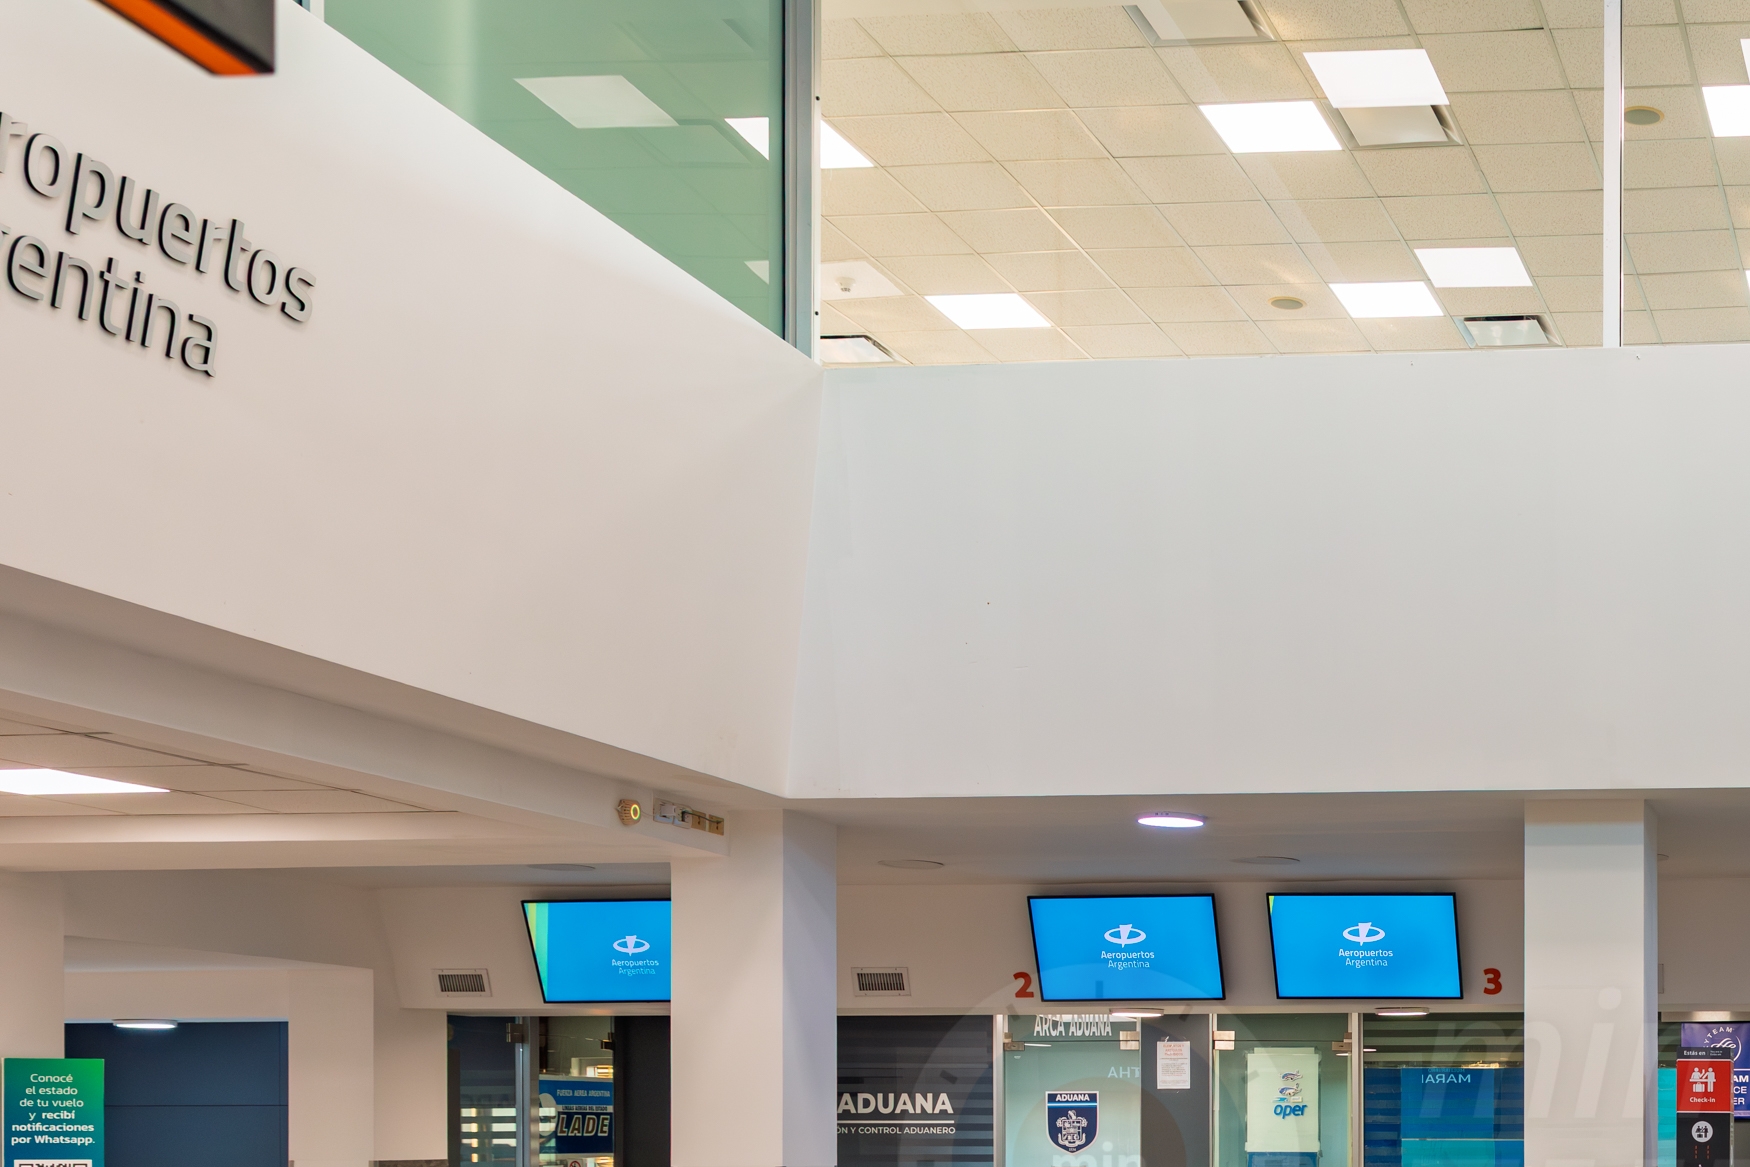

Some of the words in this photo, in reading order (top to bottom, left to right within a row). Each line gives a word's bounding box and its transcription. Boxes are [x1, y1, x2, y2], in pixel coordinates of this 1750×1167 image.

[0, 224, 218, 377] entina
[1101, 950, 1155, 961] Aeropuertos
[1339, 949, 1393, 959] Aeropuertos
[611, 959, 660, 968] Aeropuertos
[1108, 960, 1150, 970] Argentina
[1346, 958, 1388, 968] Argentina
[1013, 971, 1034, 998] 2
[1483, 968, 1503, 995] 3
[1034, 1014, 1065, 1036] ARCA
[1069, 1014, 1112, 1036] ADUANA
[30, 1073, 73, 1083] Conocé
[25, 1086, 36, 1094] el
[39, 1086, 78, 1095] estado
[19, 1098, 34, 1107] de
[37, 1098, 49, 1107] tu
[52, 1098, 84, 1107] vuelo
[1055, 1094, 1090, 1102] ADUANA
[1689, 1096, 1716, 1104] Check-in
[837, 1093, 954, 1114] ADUANA
[28, 1112, 36, 1121] y
[41, 1110, 75, 1119] recibí
[1273, 1104, 1307, 1119] oper
[12, 1122, 94, 1131] notificaciones
[557, 1115, 610, 1136] LADE
[850, 1126, 857, 1134] Y
[858, 1126, 902, 1134] CONTROL
[903, 1126, 956, 1135] ADUANERO
[11, 1136, 31, 1146] por
[34, 1135, 95, 1146] Whatsapp.
